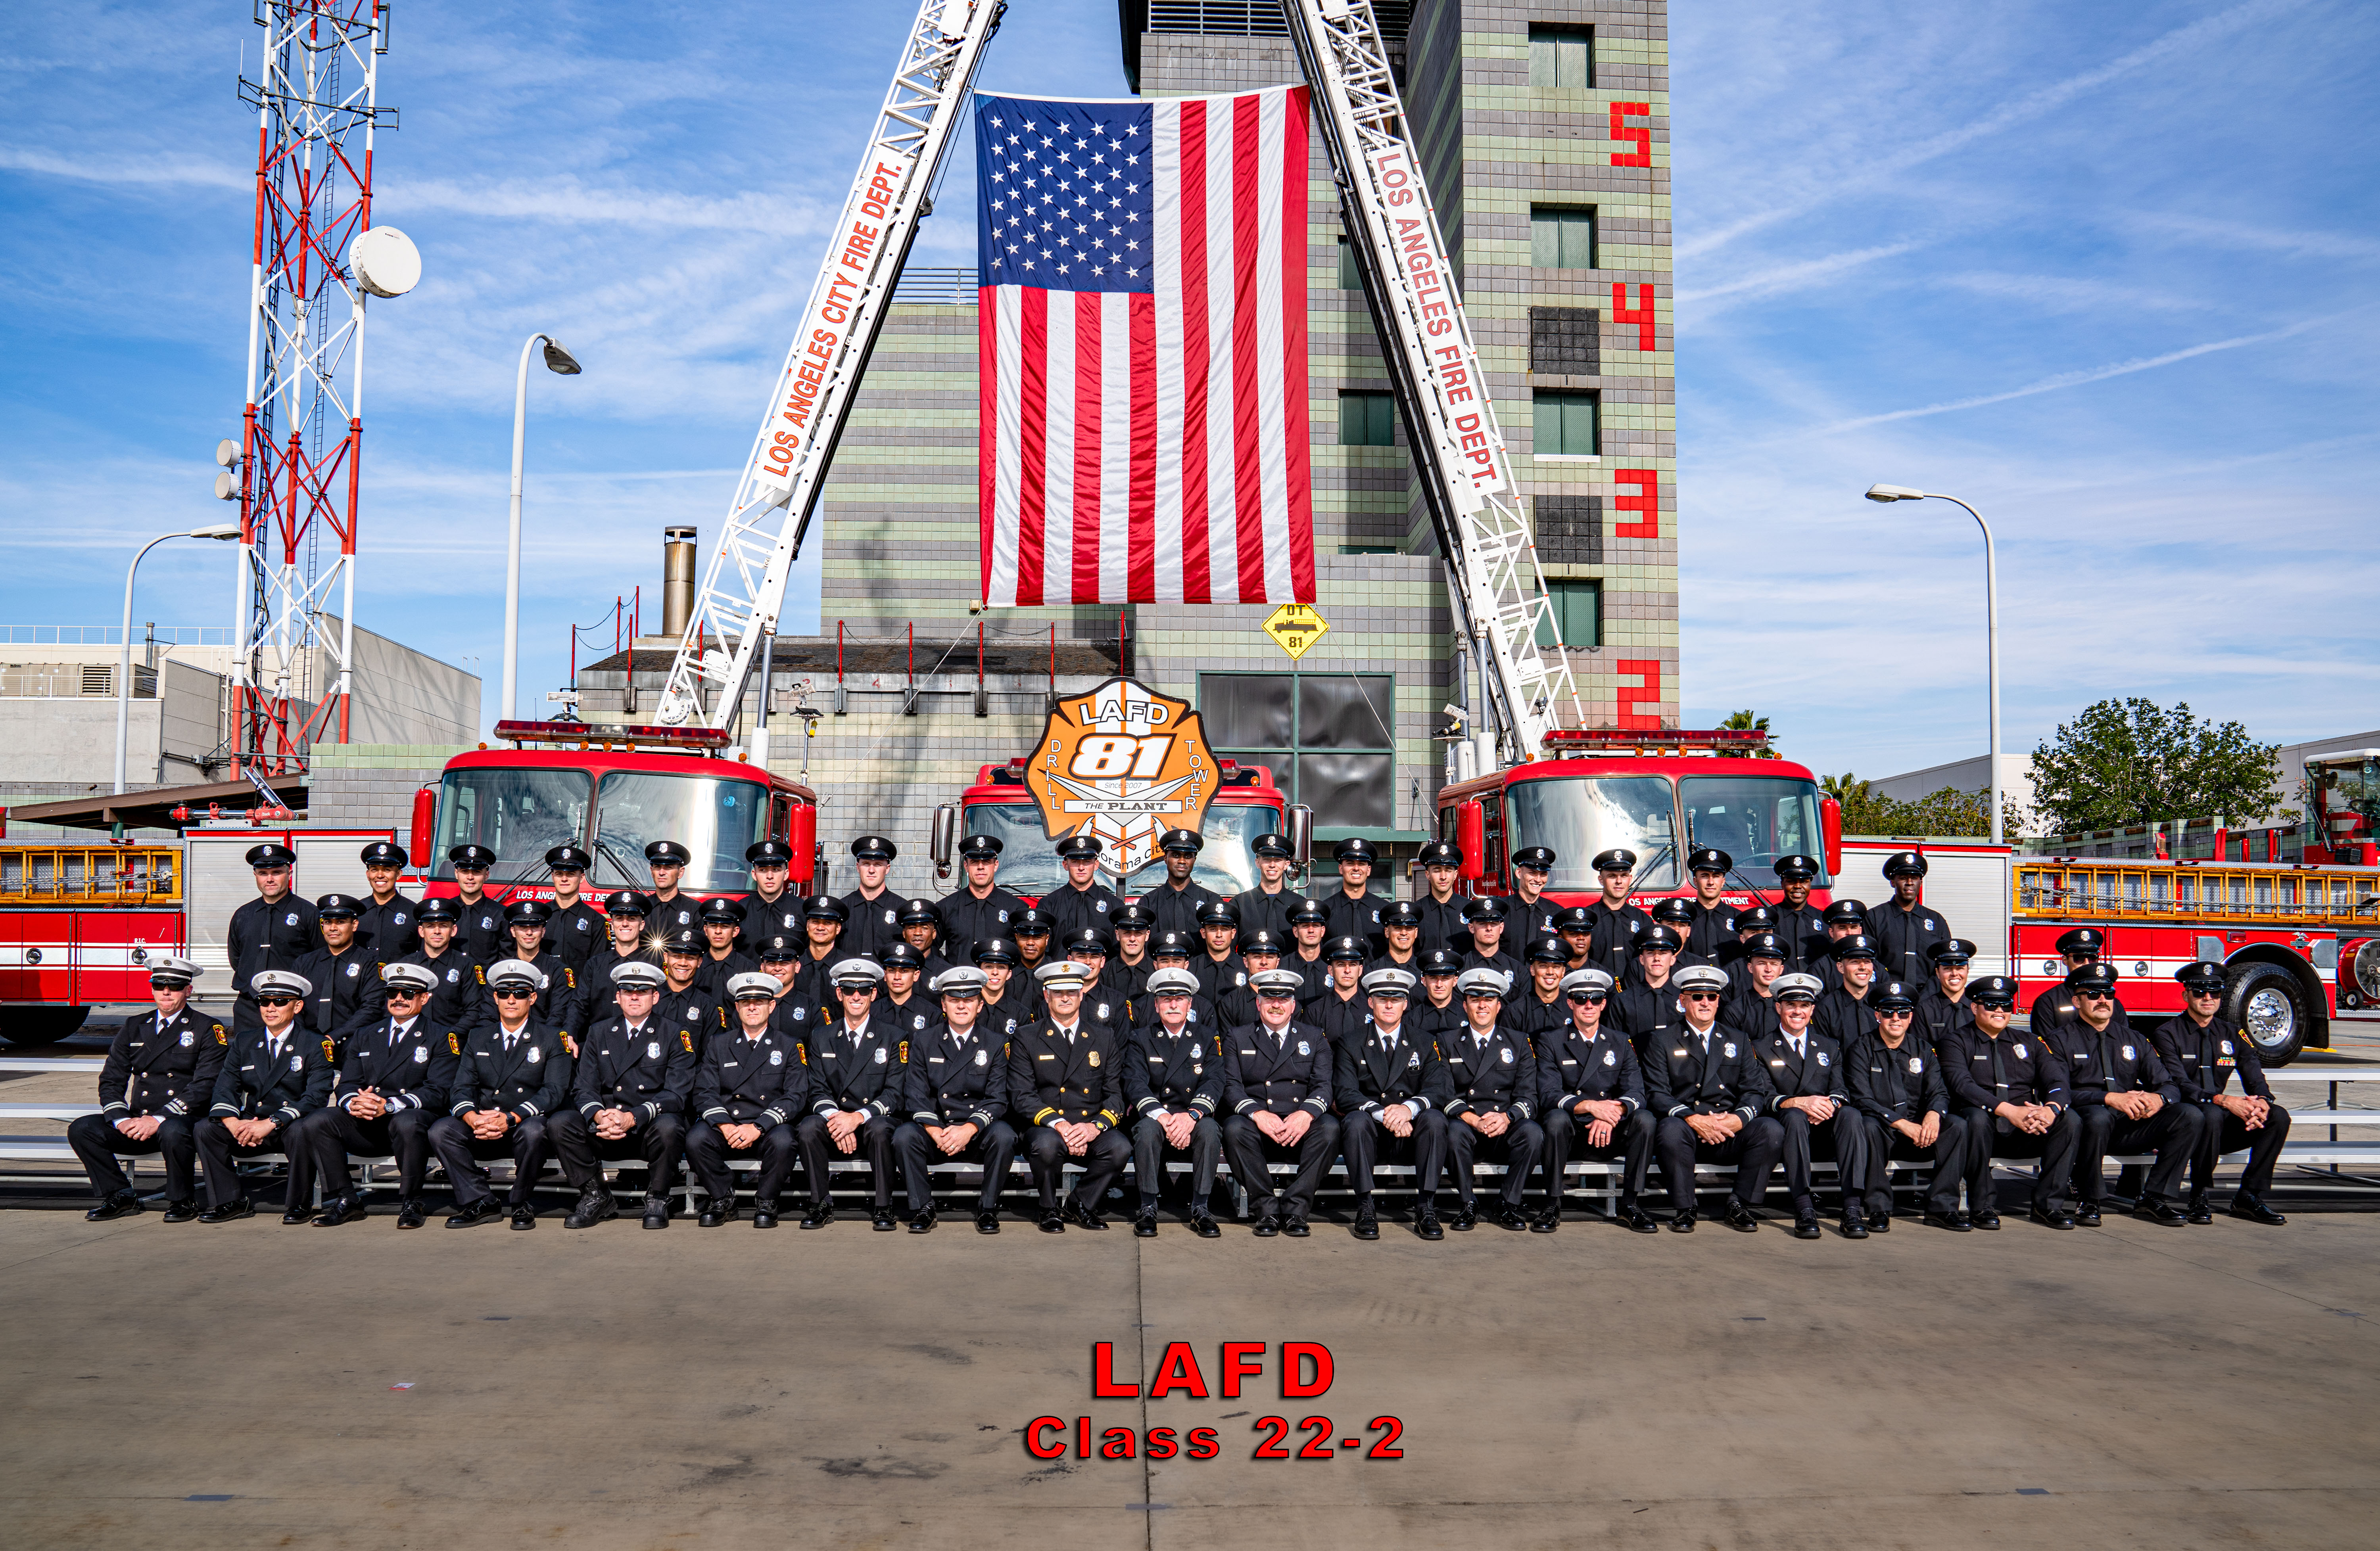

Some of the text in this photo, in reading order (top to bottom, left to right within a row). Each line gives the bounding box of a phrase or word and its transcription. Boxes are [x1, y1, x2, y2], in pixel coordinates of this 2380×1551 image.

[1609, 102, 1651, 168] 5
[764, 162, 902, 477] LOS ANGELES CITY FIRE DEPT.
[1377, 153, 1497, 488] LOS ANGELES FIRE DEPT.
[1612, 283, 1656, 352] 4
[1614, 468, 1658, 539] 3
[1287, 605, 1305, 615] DT
[1289, 637, 1302, 648] 81
[1079, 700, 1169, 726] LAFD
[1617, 660, 1660, 730] 2
[1045, 739, 1062, 810] DRILL
[1068, 732, 1177, 781] 81
[1184, 740, 1209, 811] TOWER
[1107, 802, 1167, 811] PLANT
[1144, 844, 1164, 859] Cit
[516, 891, 534, 899] LOS
[578, 893, 593, 901] IRE
[1628, 897, 1641, 907] OS
